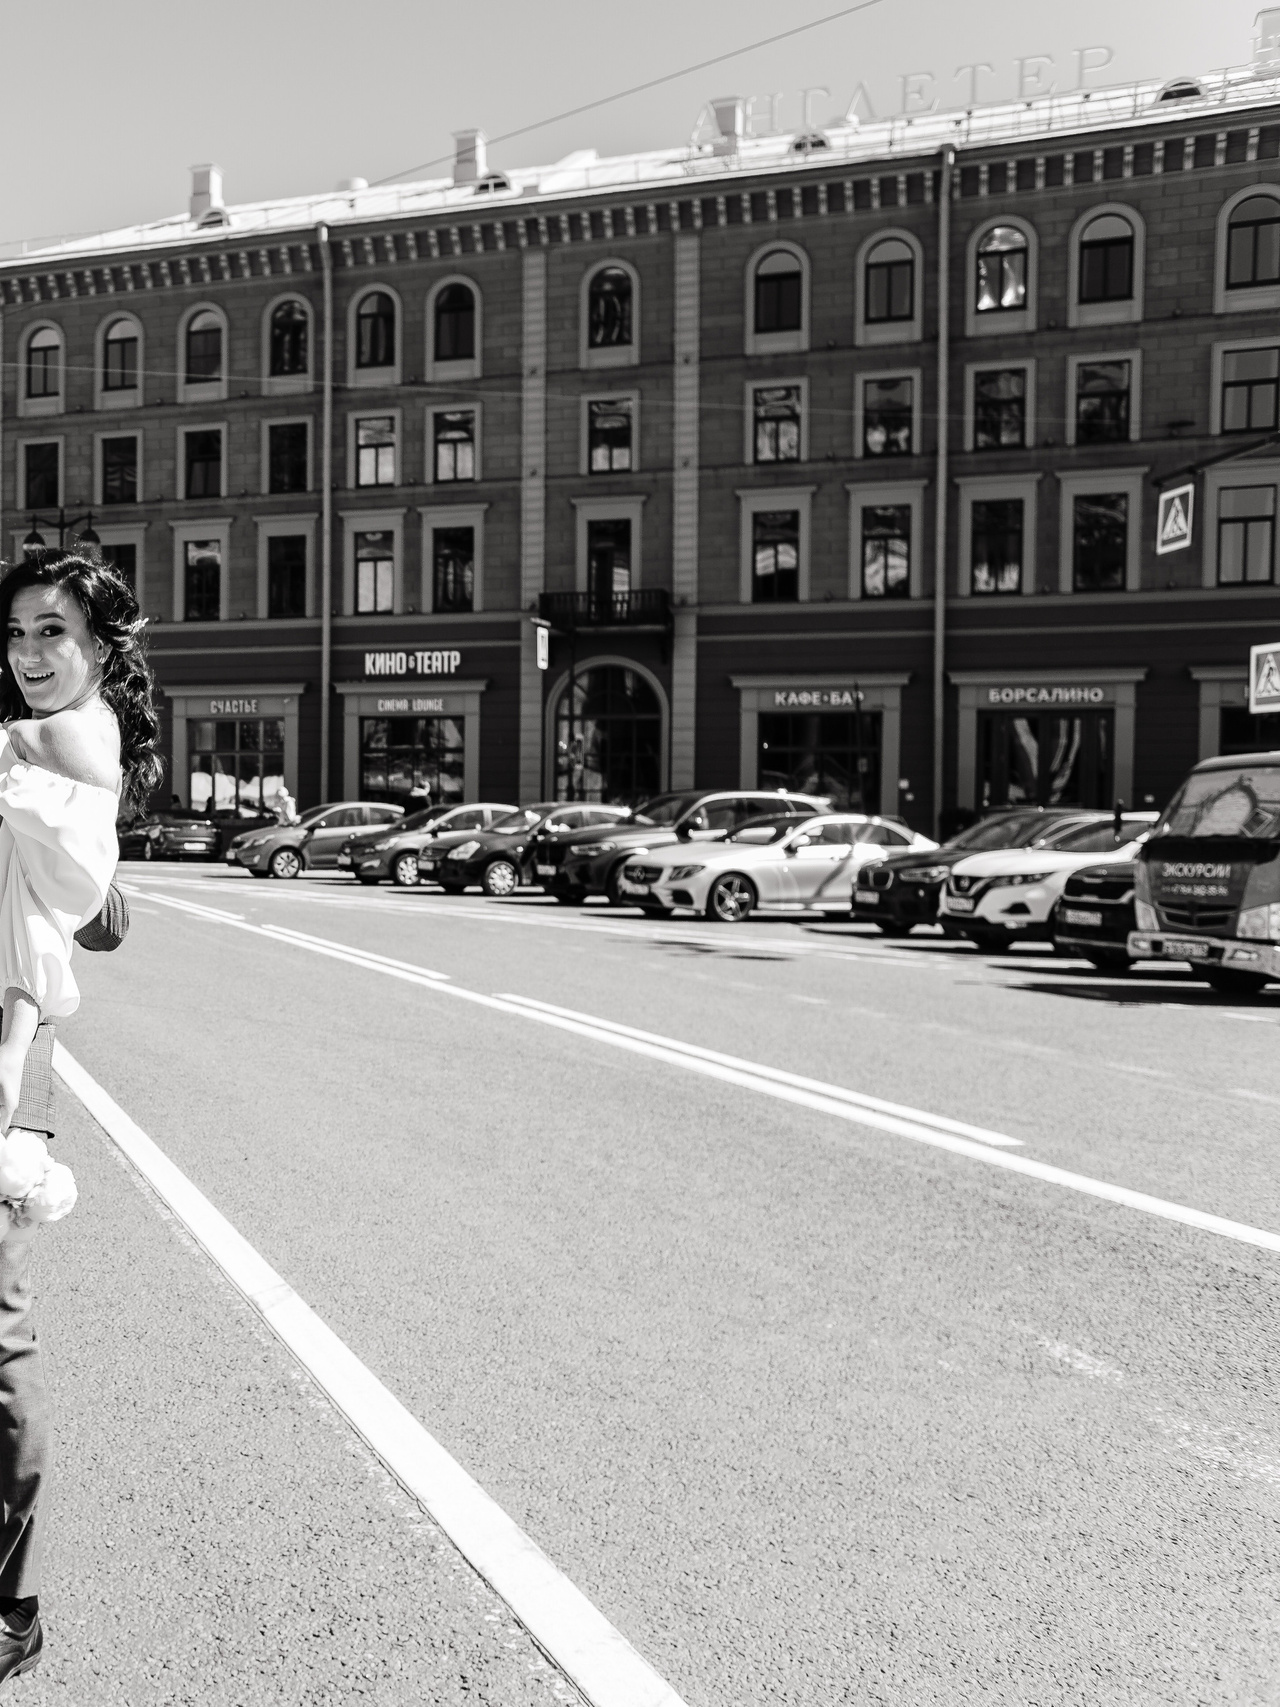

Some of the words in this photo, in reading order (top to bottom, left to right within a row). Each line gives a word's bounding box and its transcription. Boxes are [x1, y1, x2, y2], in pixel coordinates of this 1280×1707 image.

[691, 46, 1116, 144] АНГЛЕТЕР
[988, 687, 1104, 703] БОРСАЛИНО
[210, 700, 258, 714] СЧАСТЬЕ
[378, 699, 408, 712] CINEMA
[412, 698, 444, 712] LOUNGE
[1162, 863, 1232, 878] ЭКСКУРСИИ
